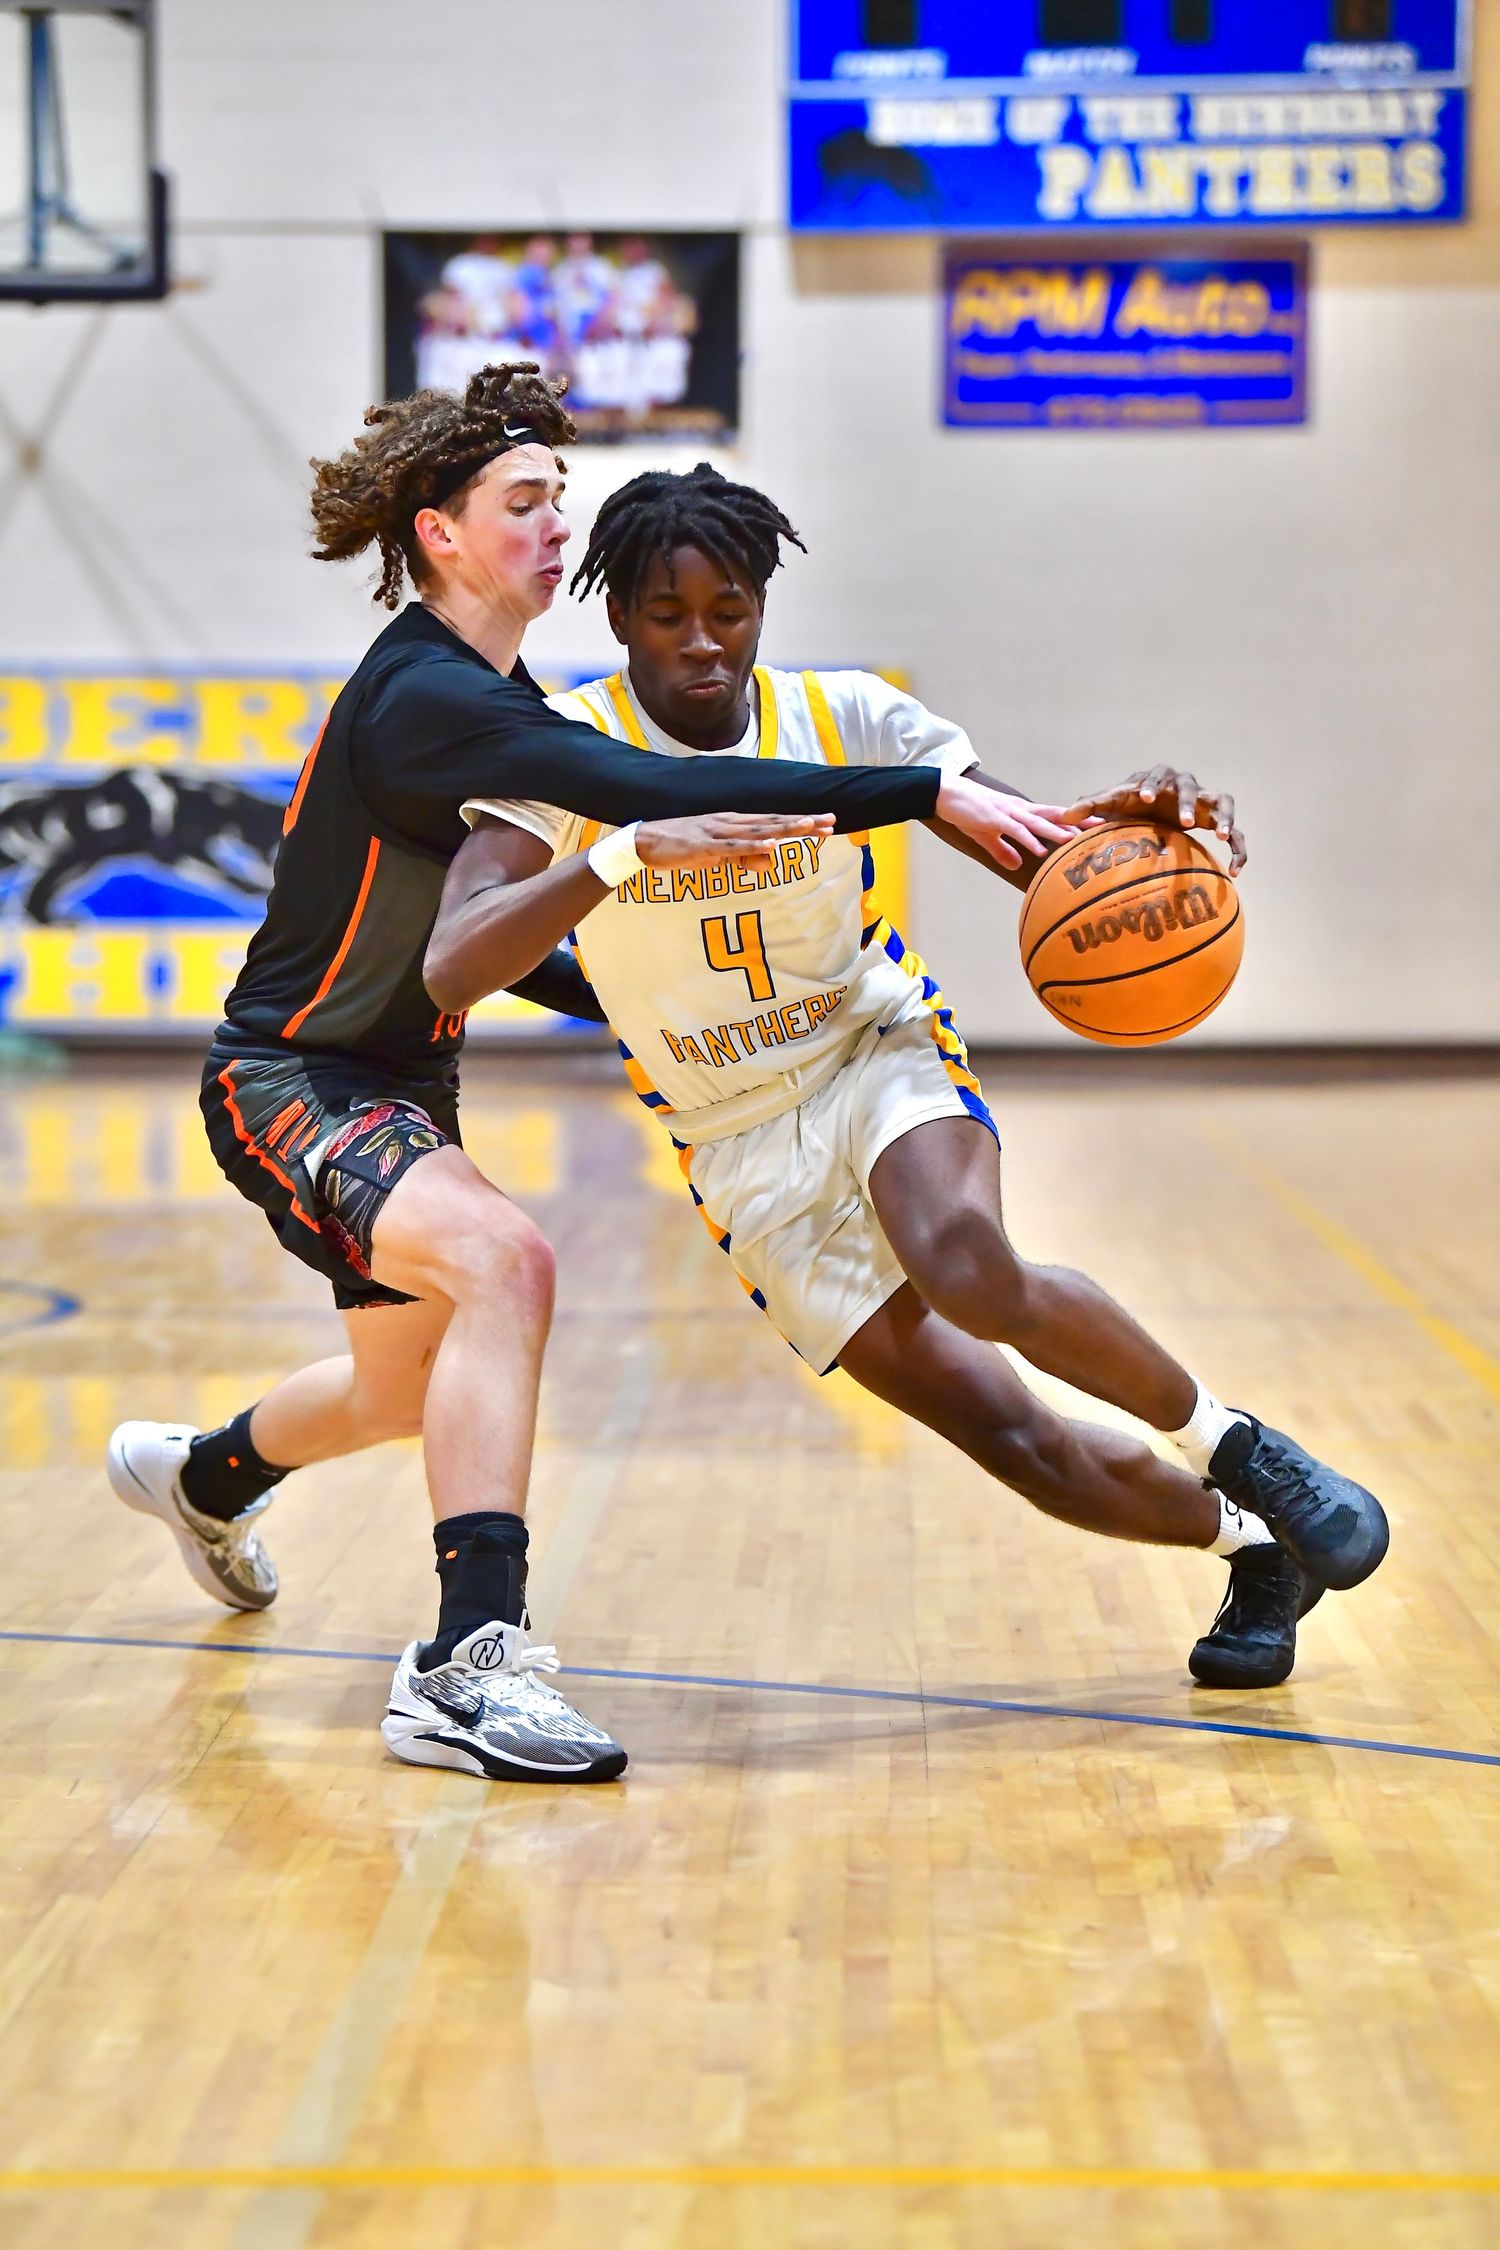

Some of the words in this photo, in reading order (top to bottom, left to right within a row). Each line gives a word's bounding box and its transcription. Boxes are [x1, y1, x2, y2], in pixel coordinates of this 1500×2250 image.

[1037, 143, 1444, 219] PANTHERS
[952, 267, 1108, 336] RPM
[617, 836, 827, 904] NEWBERRY
[1063, 837, 1169, 890] NCAA
[1067, 883, 1219, 954] Wilson
[700, 910, 777, 1002] 4
